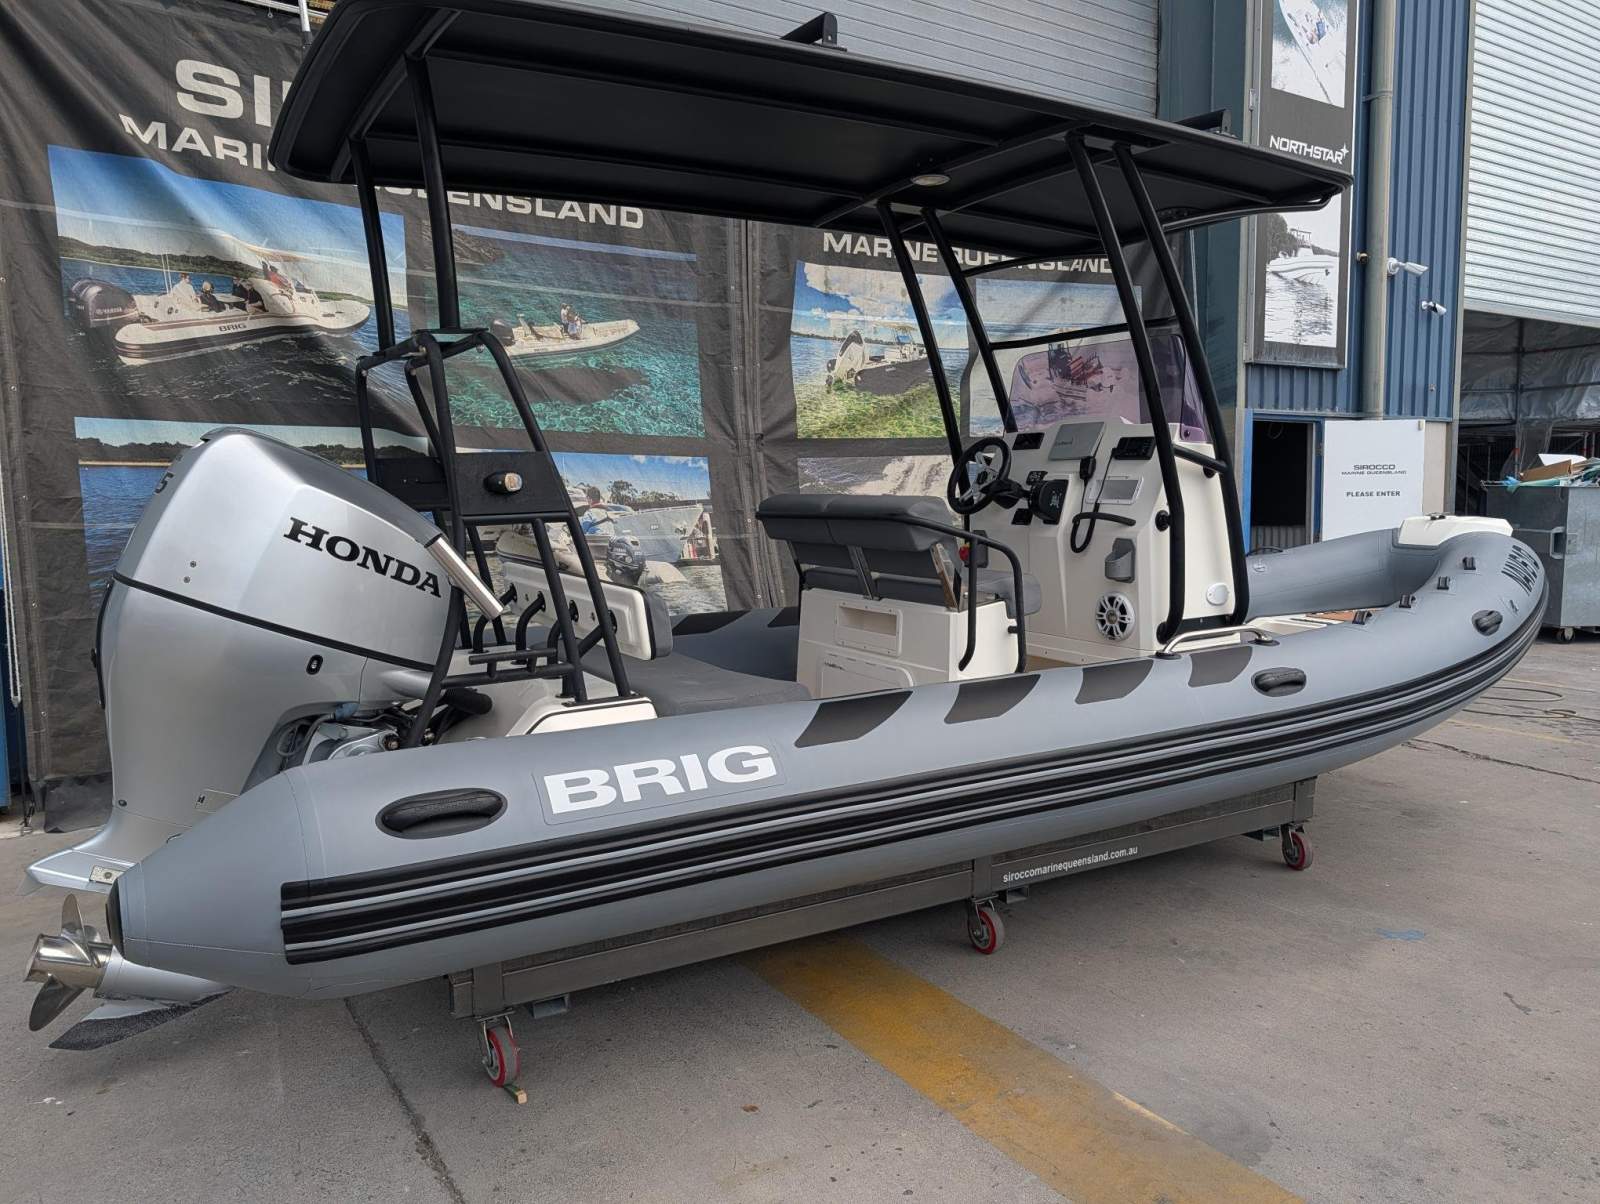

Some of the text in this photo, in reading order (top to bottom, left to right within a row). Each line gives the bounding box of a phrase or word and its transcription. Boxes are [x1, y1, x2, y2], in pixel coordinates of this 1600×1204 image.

[176, 59, 292, 127] SI
[1269, 134, 1343, 165] NORTHSTAR
[823, 232, 938, 262] MARNE
[283, 516, 442, 598] HONDA
[543, 745, 778, 815] BRIG
[1003, 845, 1138, 883] siroccomarinequeensland.com.au
